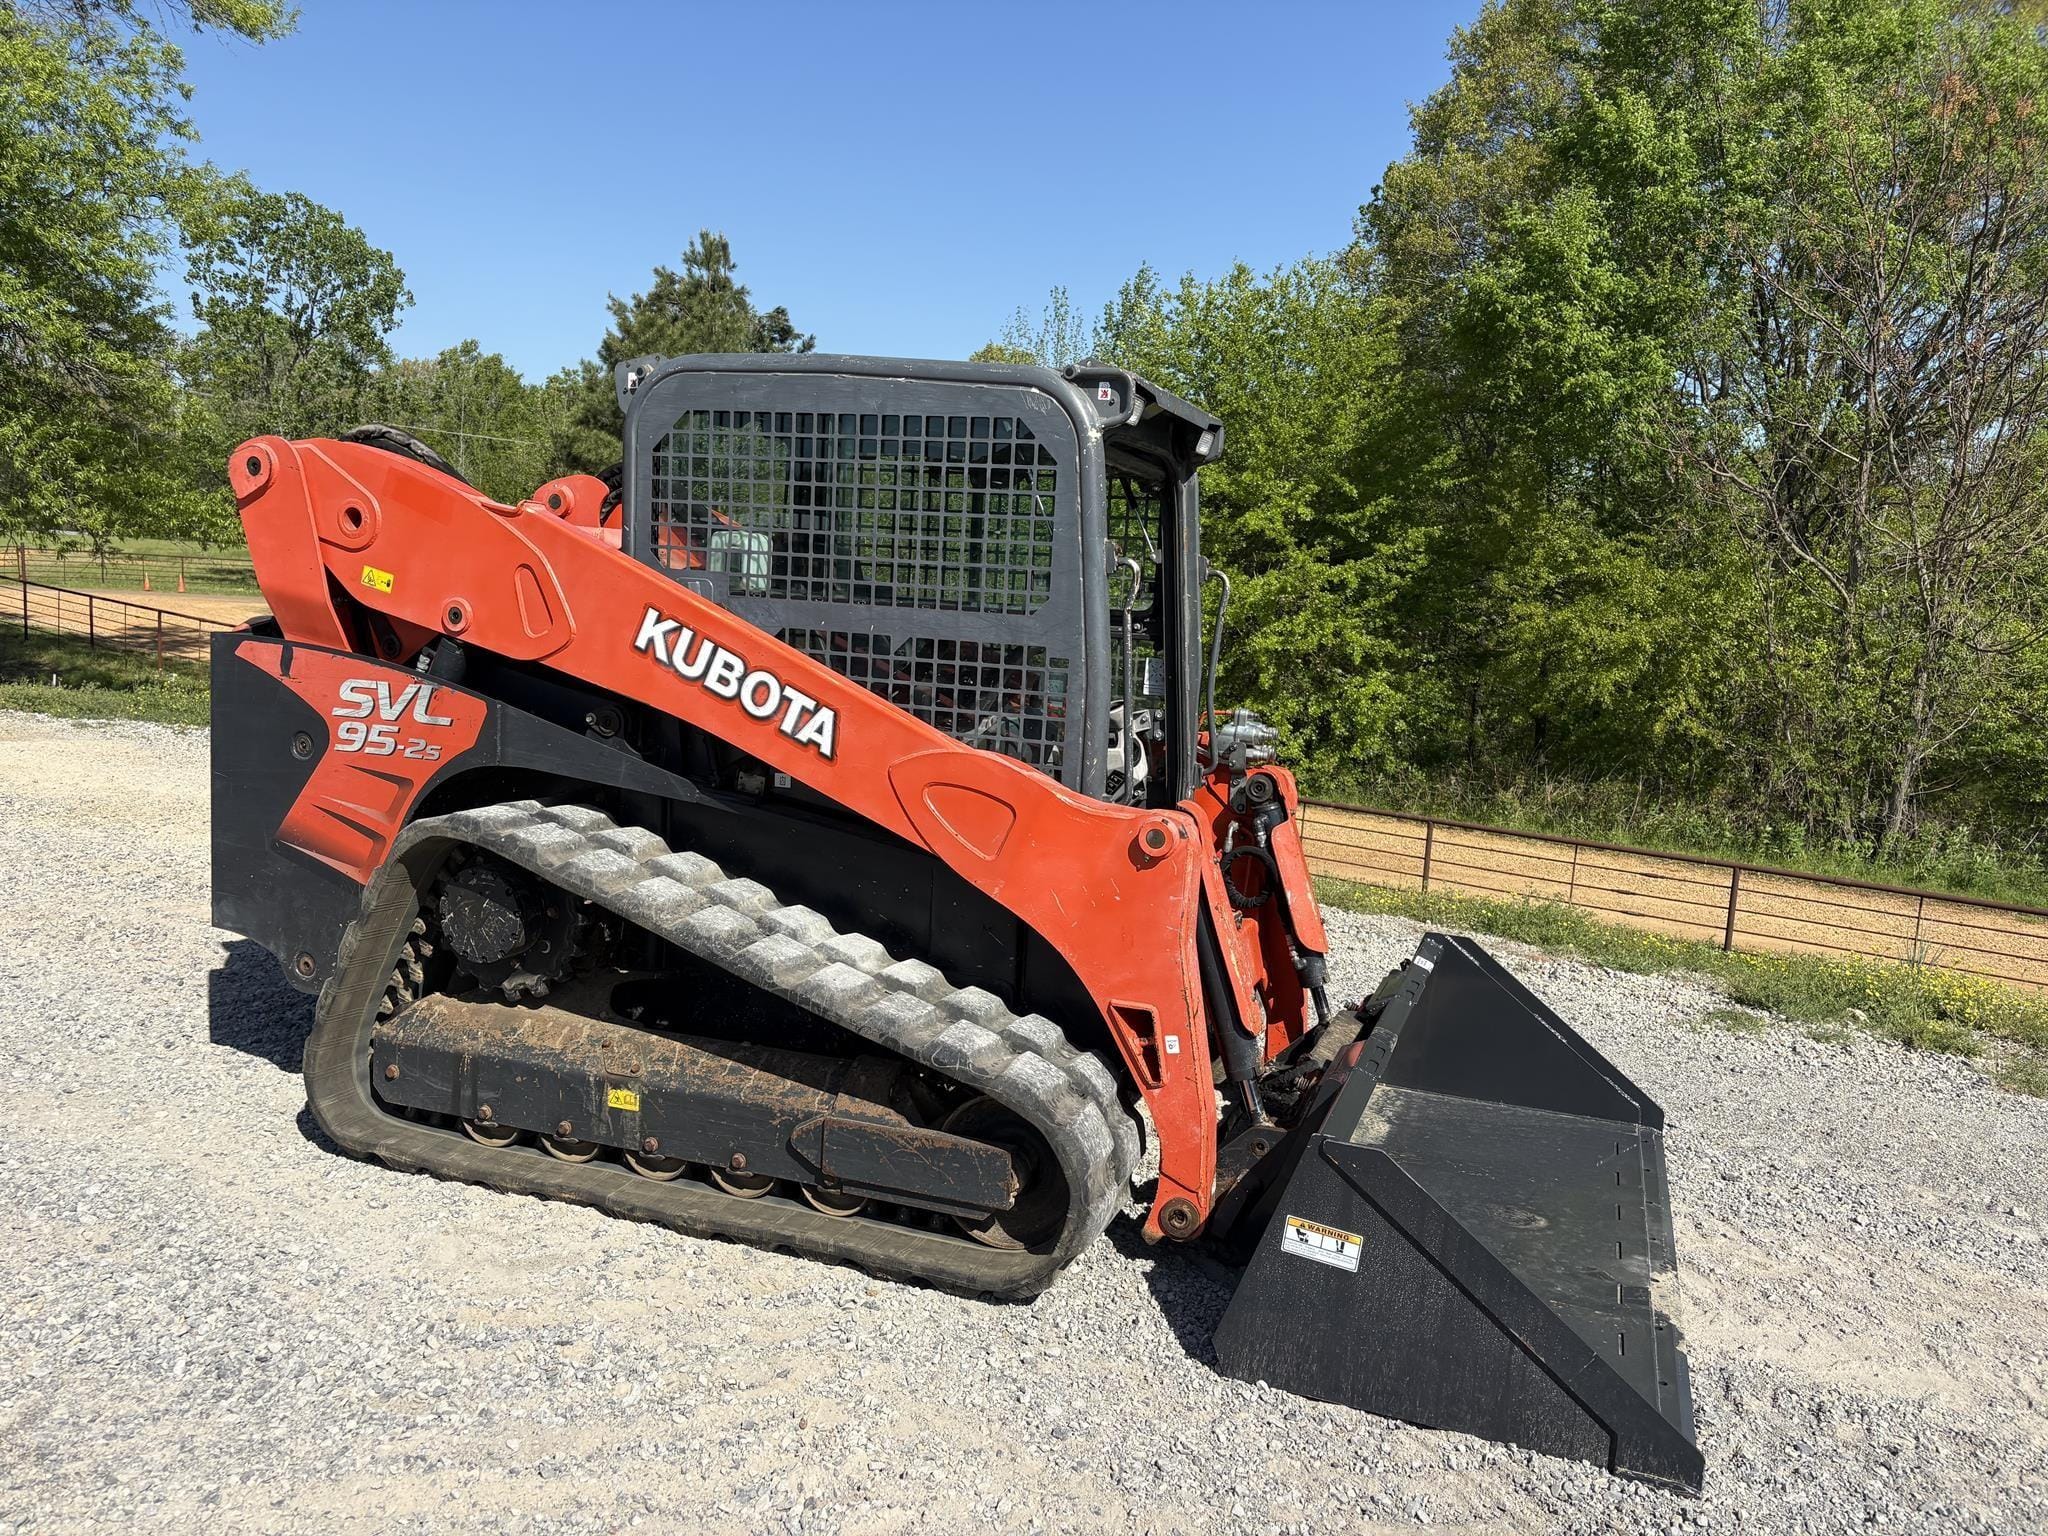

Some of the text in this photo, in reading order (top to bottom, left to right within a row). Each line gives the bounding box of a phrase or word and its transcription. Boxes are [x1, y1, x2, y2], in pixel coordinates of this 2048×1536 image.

[331, 678, 453, 727] SVL
[634, 606, 837, 760] KUBOTA
[1307, 1223, 1350, 1241] WARNING
